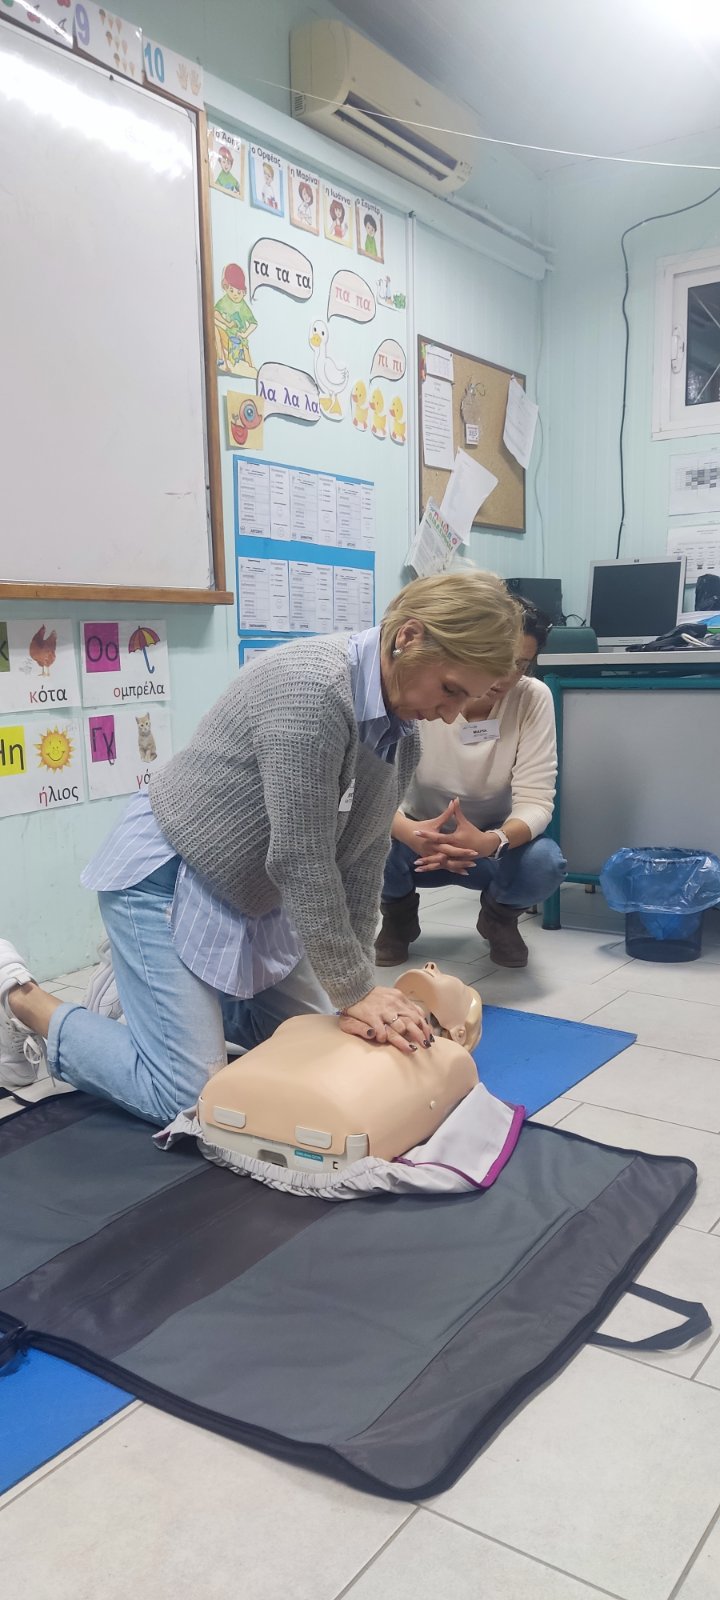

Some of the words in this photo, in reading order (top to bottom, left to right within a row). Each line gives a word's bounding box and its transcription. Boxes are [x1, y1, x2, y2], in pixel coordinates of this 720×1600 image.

[75, 4, 90, 46] 9
[144, 43, 165, 83] 10
[253, 259, 270, 277] τα
[275, 265, 290, 284] τα
[295, 272, 312, 290] τα
[335, 286, 350, 302] πα
[356, 295, 371, 312] πα
[259, 380, 277, 402] λα
[284, 387, 300, 408] λα
[305, 394, 320, 414] λα
[30, 685, 67, 703] κότα
[114, 682, 165, 700] ομπρέλα
[39, 786, 79, 806] ήλιος
